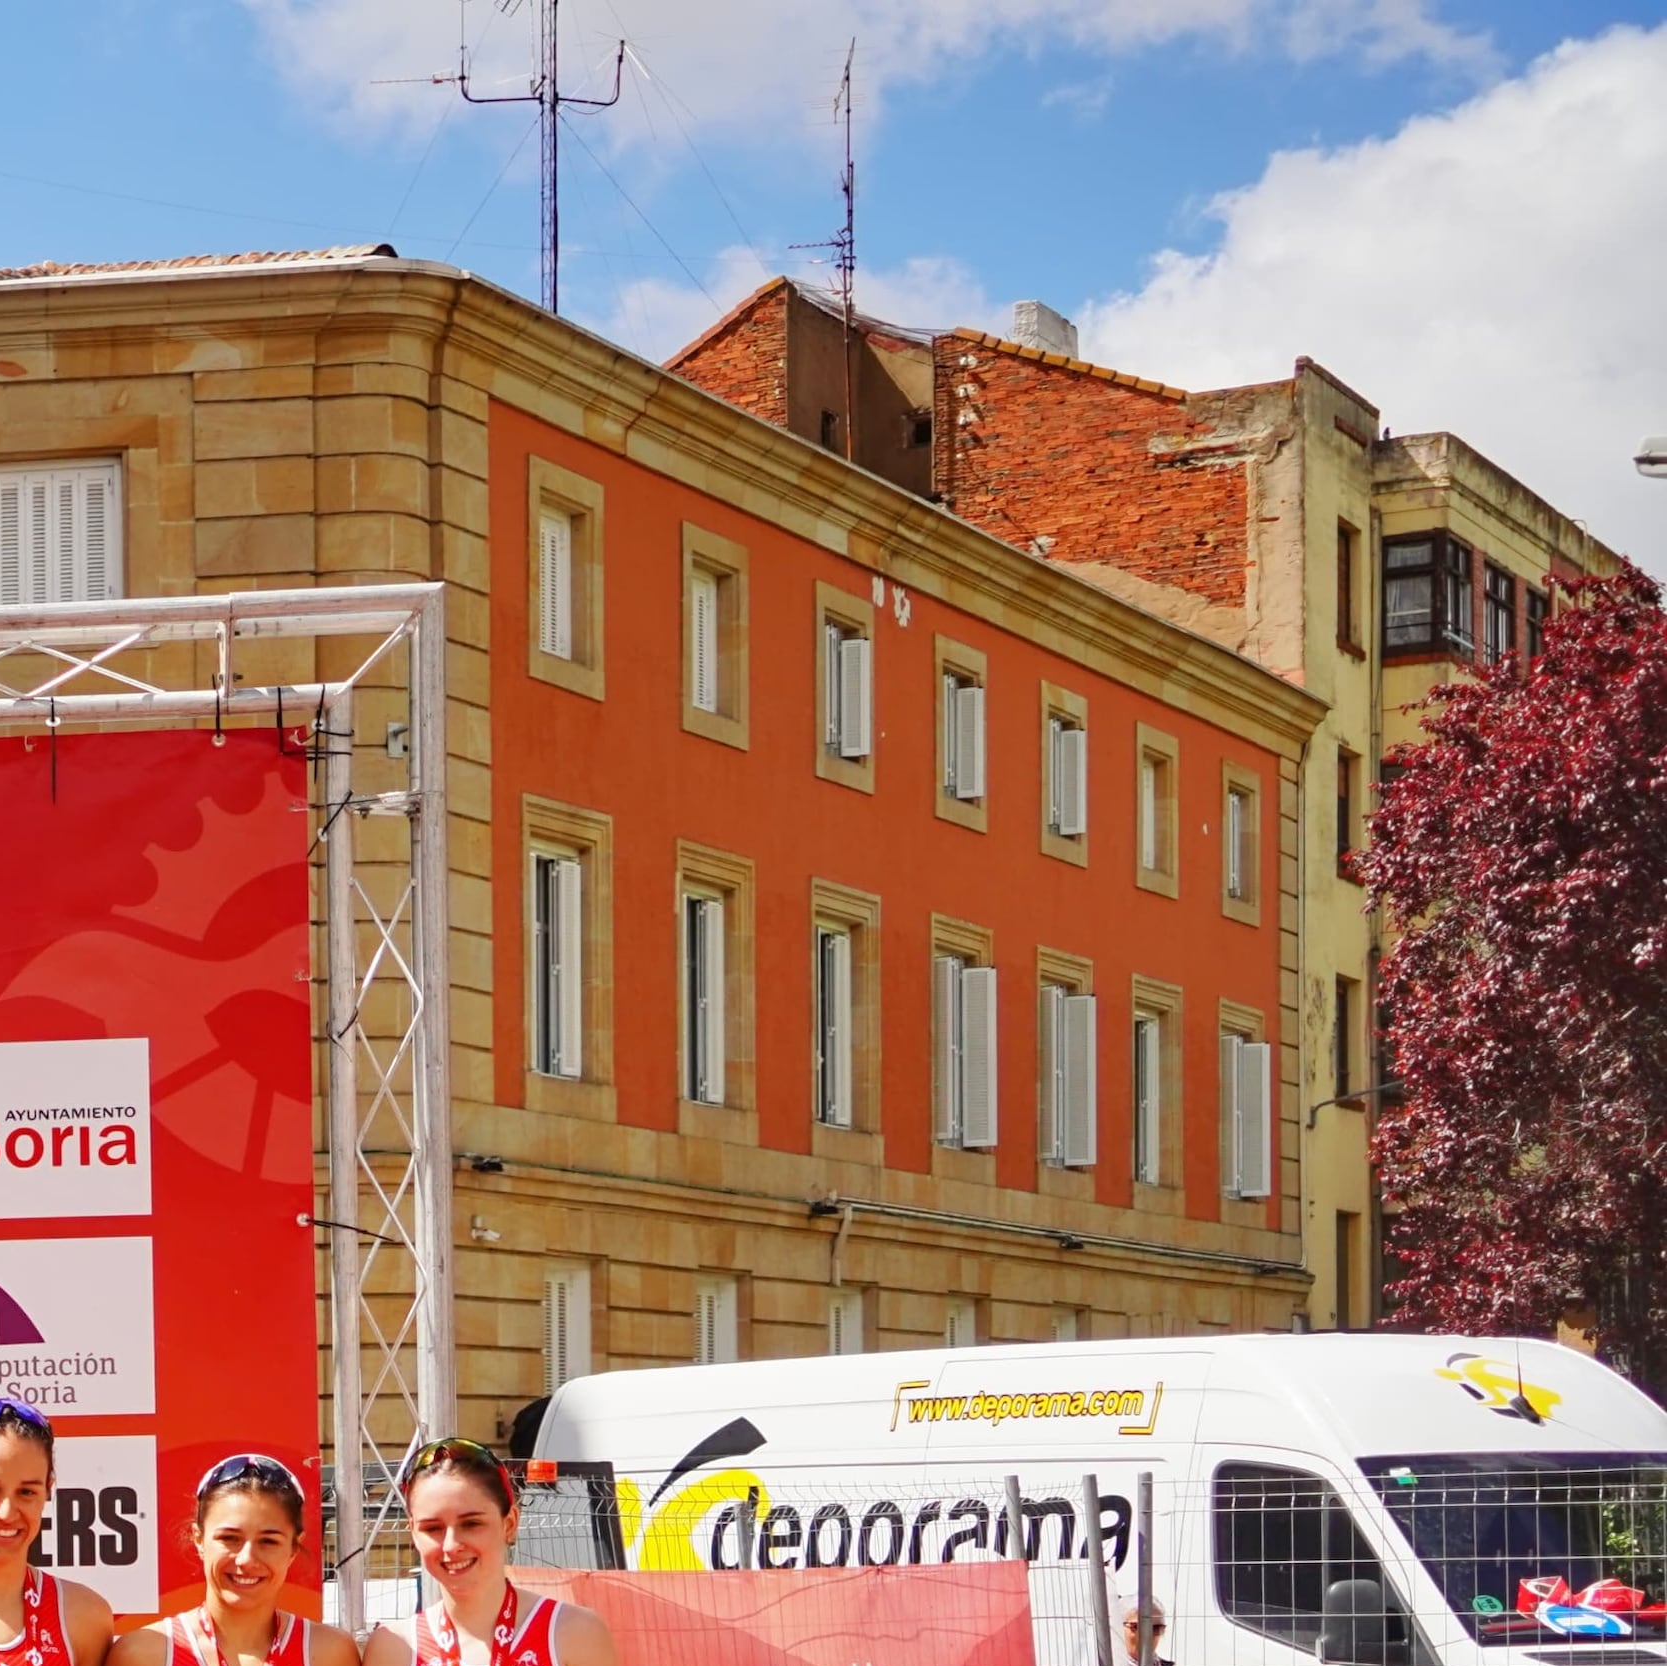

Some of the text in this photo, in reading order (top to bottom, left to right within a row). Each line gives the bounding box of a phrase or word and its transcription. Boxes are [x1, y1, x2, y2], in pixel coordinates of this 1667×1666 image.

[5, 1104, 136, 1121] AYUNTAMIENTO
[7, 1379, 77, 1405] Soria
[907, 1389, 1145, 1427] www.deporama.com
